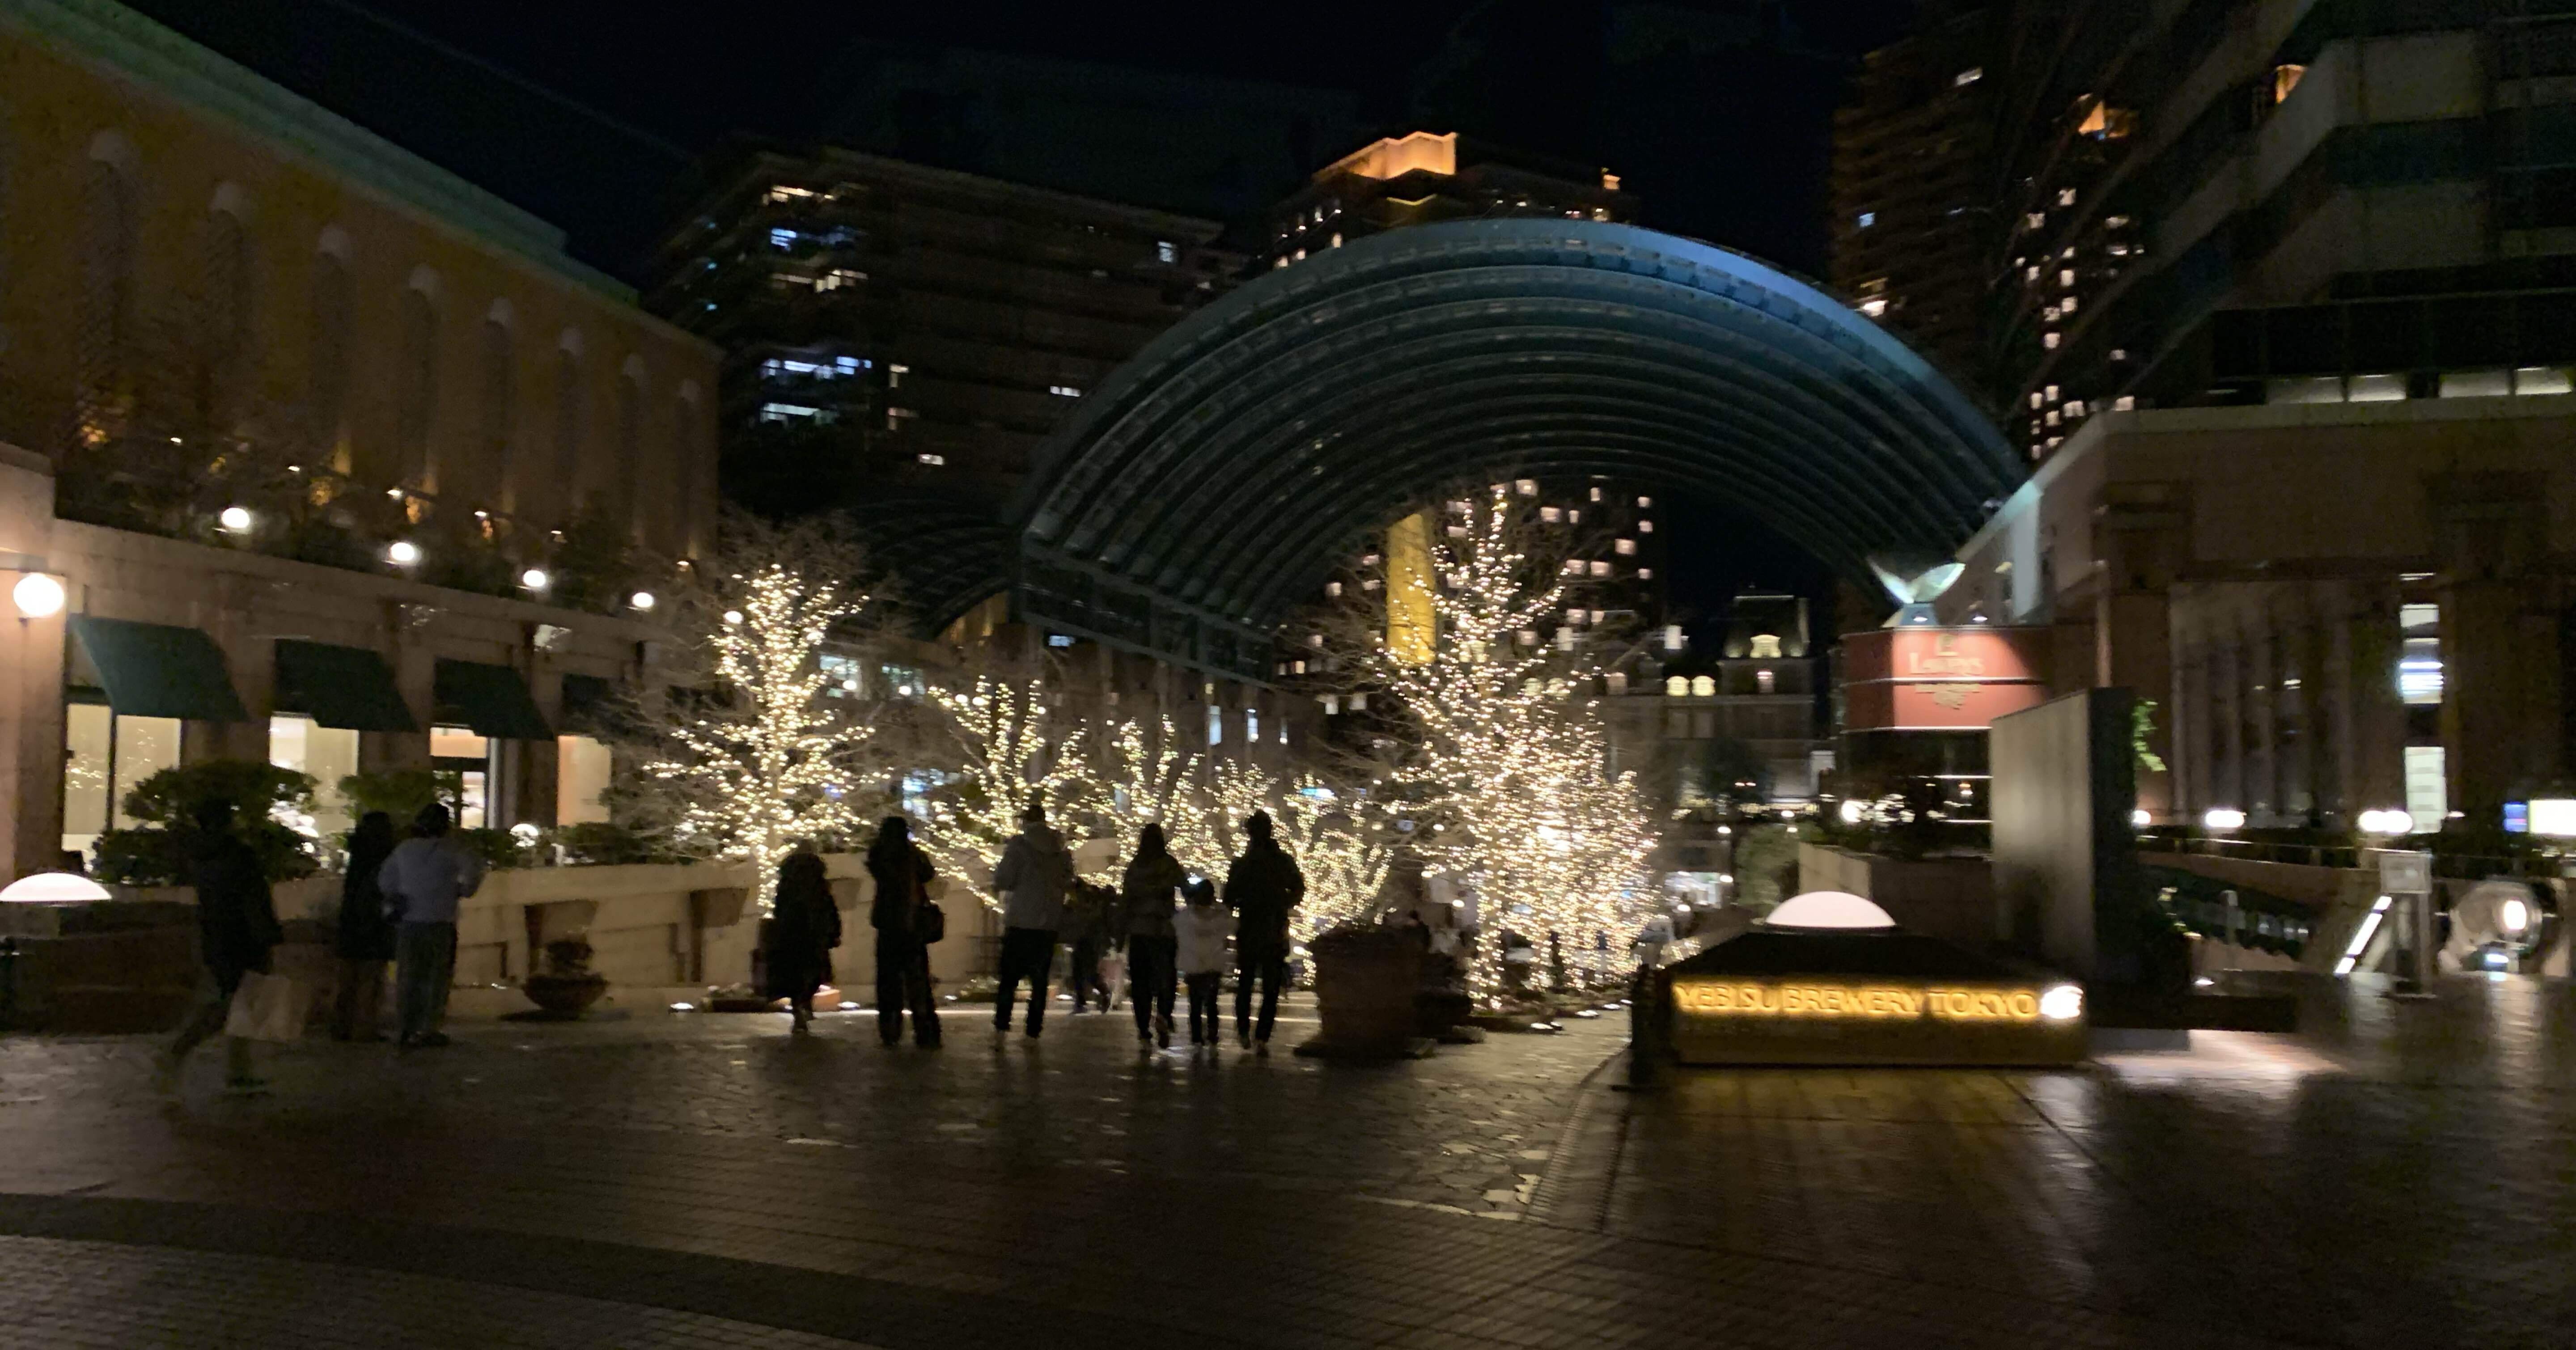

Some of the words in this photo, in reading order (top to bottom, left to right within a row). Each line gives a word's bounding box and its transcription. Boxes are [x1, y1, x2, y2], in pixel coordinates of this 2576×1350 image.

[1674, 984, 1779, 1011] YEBISU
[1784, 986, 1923, 1016] BREWERY
[1927, 990, 2038, 1018] TOKYO
